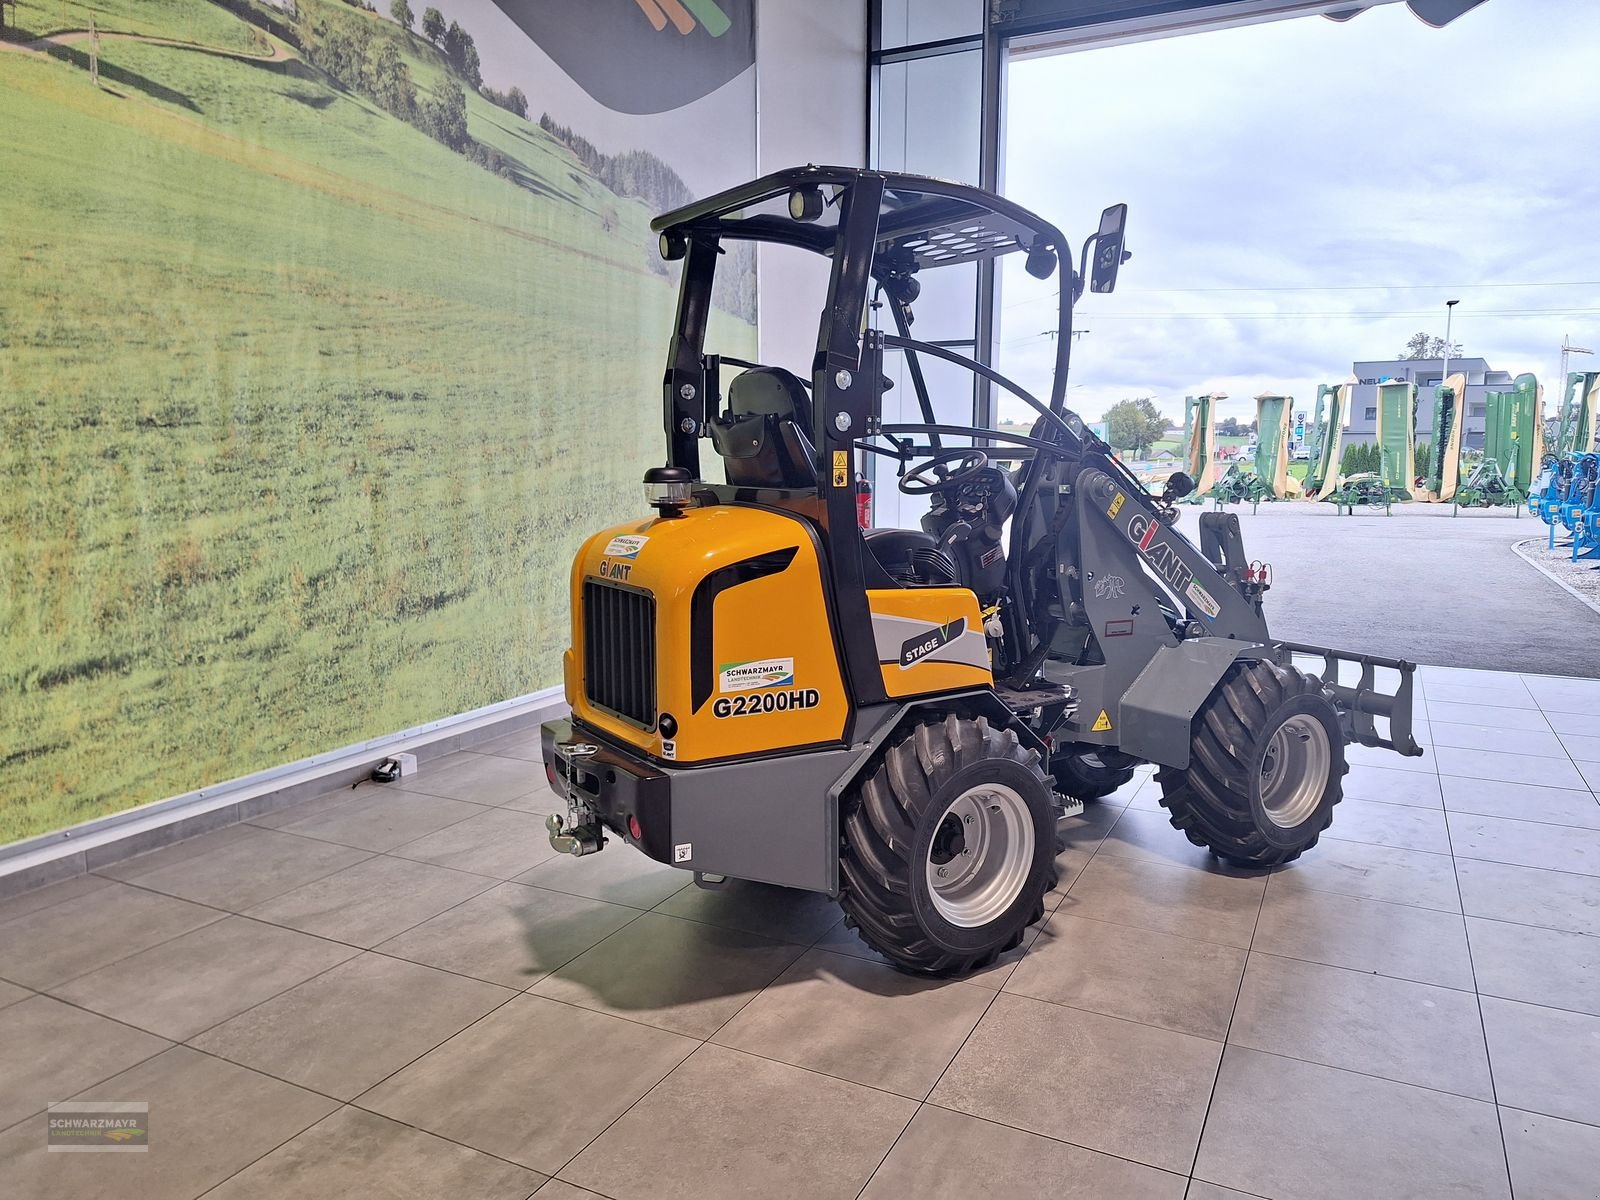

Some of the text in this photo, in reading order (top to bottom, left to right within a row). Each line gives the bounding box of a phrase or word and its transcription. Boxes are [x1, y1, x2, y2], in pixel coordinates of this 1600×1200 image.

[905, 637, 939, 662] STAGE
[726, 665, 784, 677] SCHWARZMAYR
[727, 675, 761, 683] LANDTECHNIK
[712, 688, 820, 719] G2200HD
